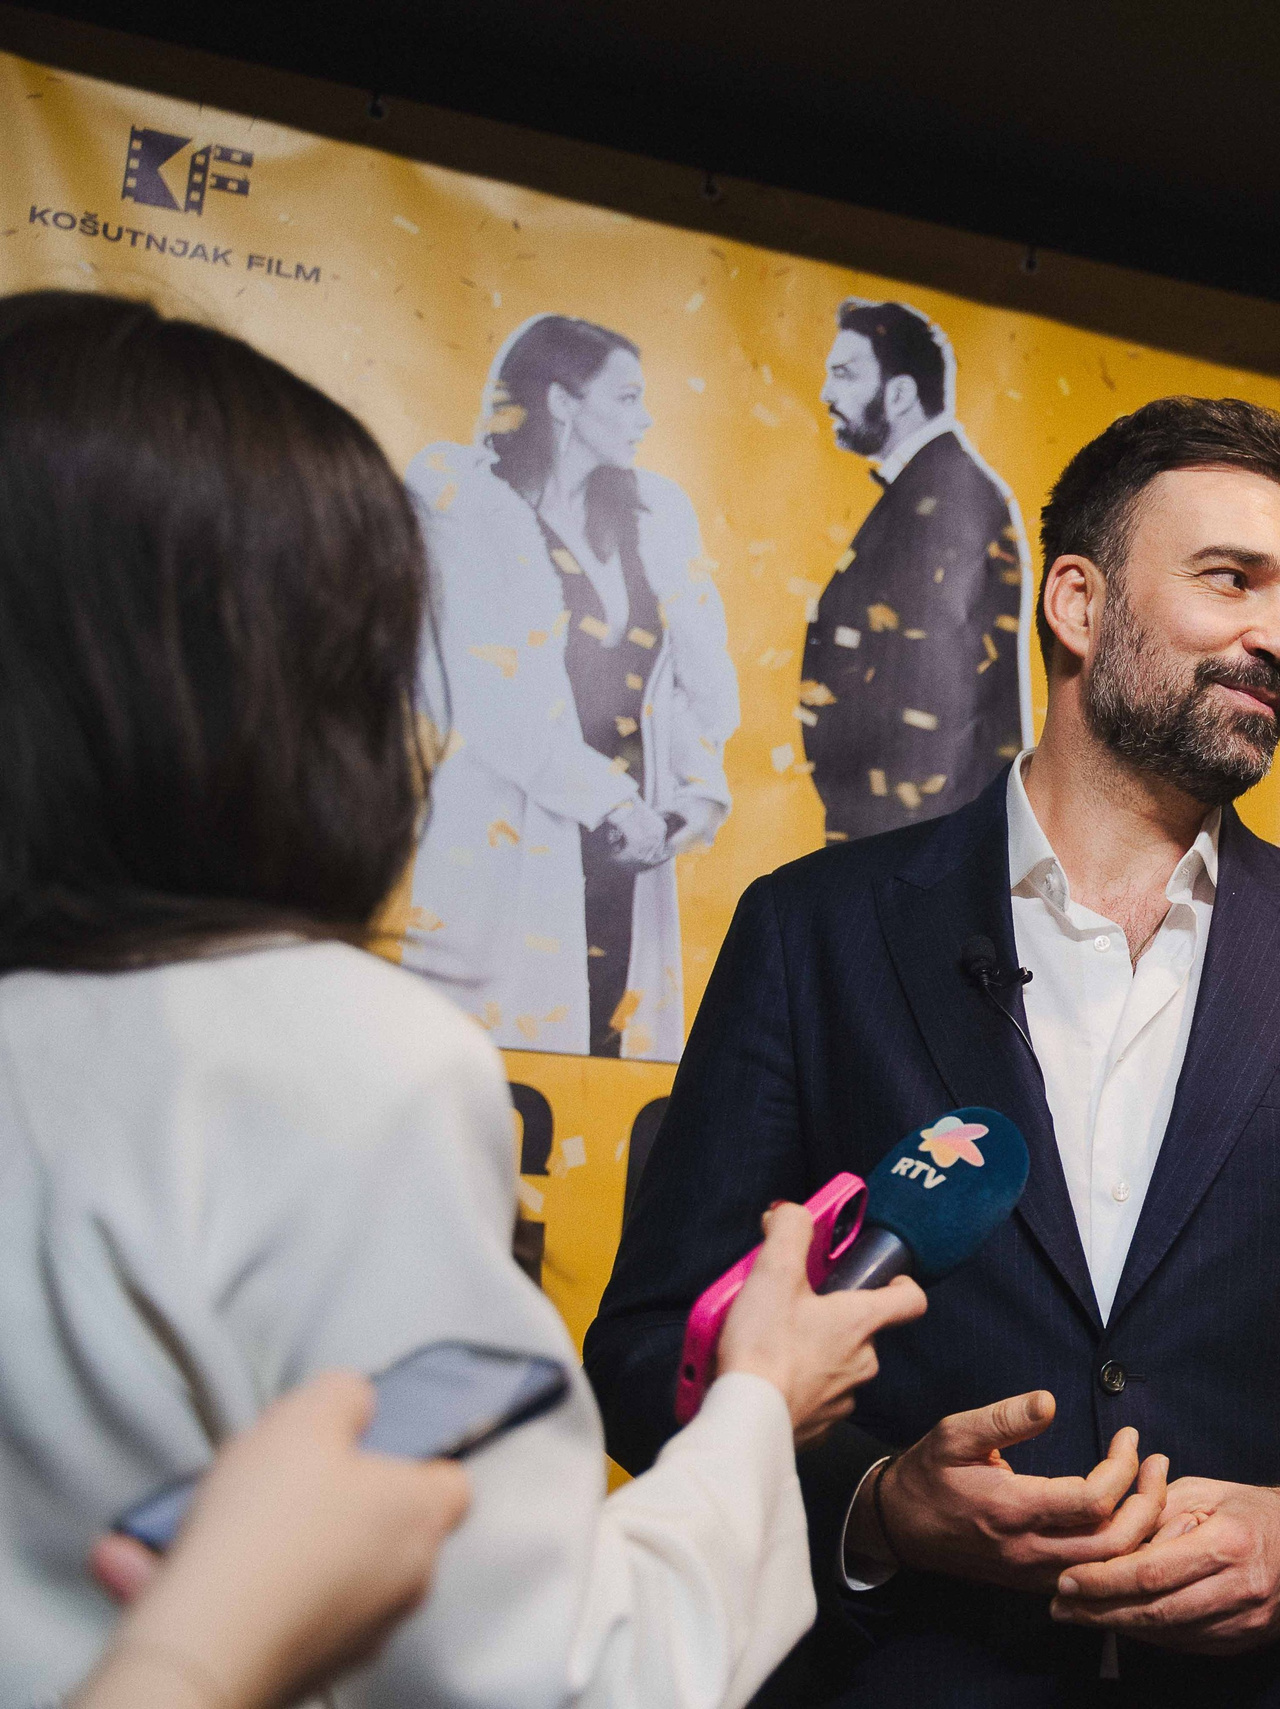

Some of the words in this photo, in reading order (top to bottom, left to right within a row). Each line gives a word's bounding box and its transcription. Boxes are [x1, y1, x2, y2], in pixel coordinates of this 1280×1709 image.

[28, 205, 232, 267] KOŠUTNJAK
[246, 254, 321, 284] FILM
[891, 1156, 947, 1190] RTV
